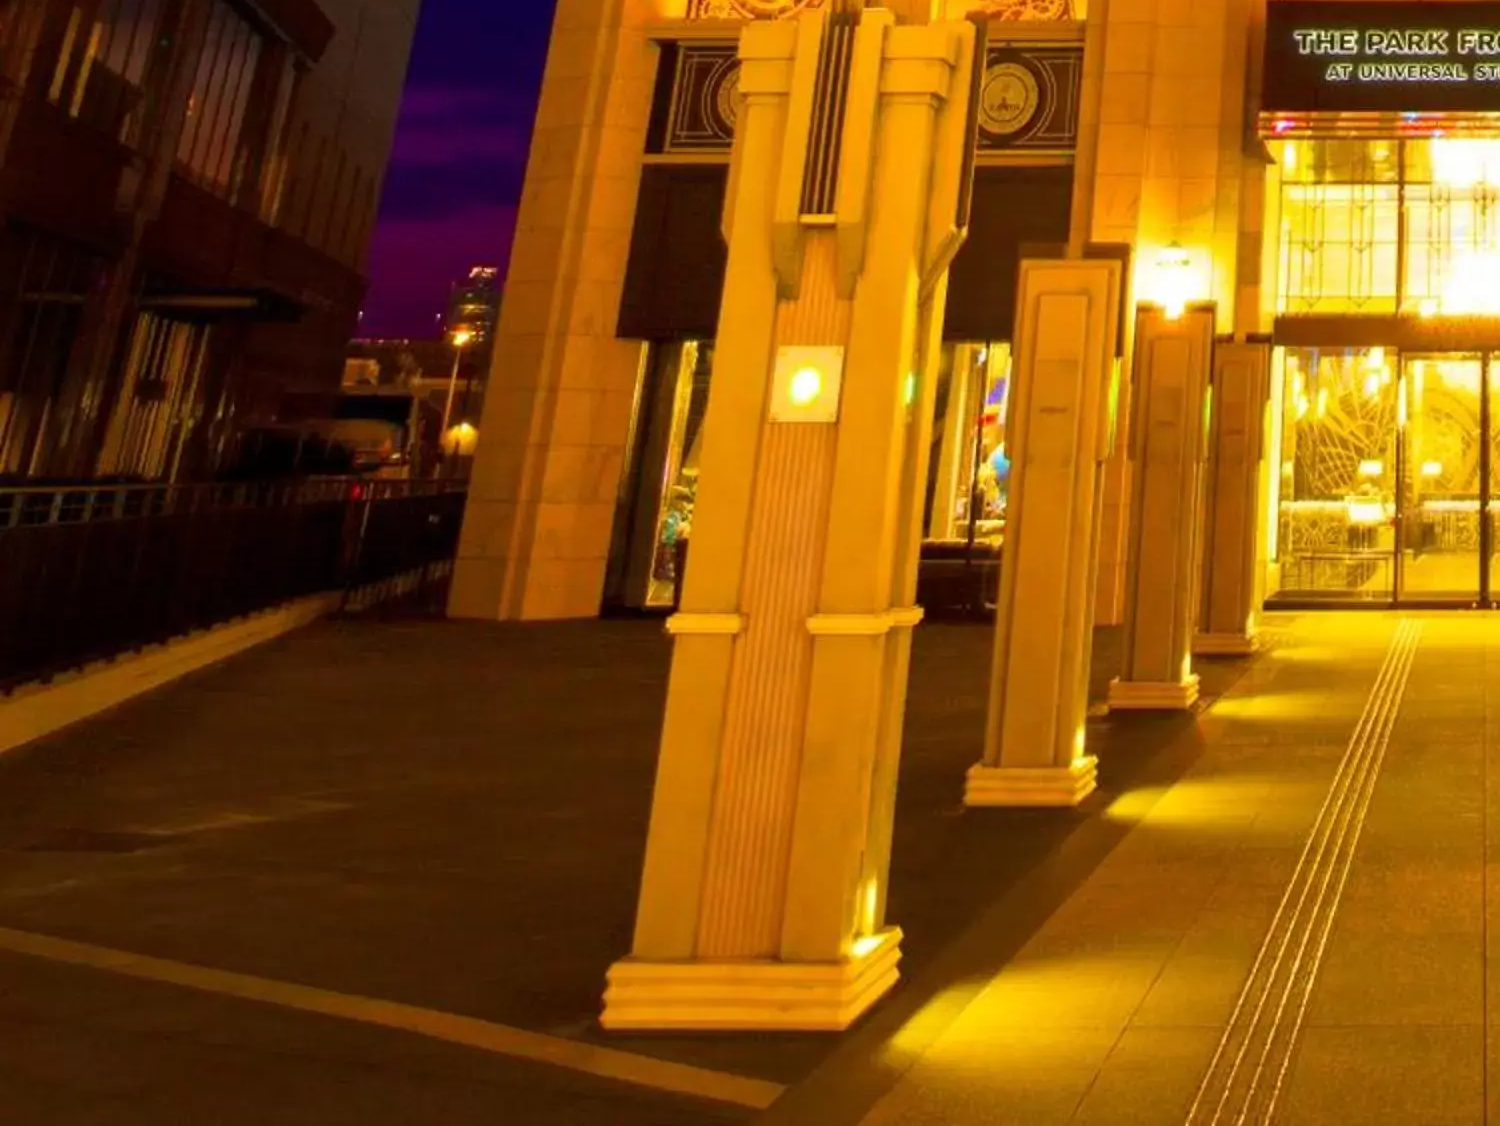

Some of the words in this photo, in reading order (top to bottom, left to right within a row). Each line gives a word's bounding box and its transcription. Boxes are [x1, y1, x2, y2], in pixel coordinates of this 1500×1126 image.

[1293, 29, 1358, 55] THE
[1365, 29, 1449, 55] PARK
[1325, 63, 1353, 81] AT
[1359, 63, 1468, 81] UNIVERSAL
